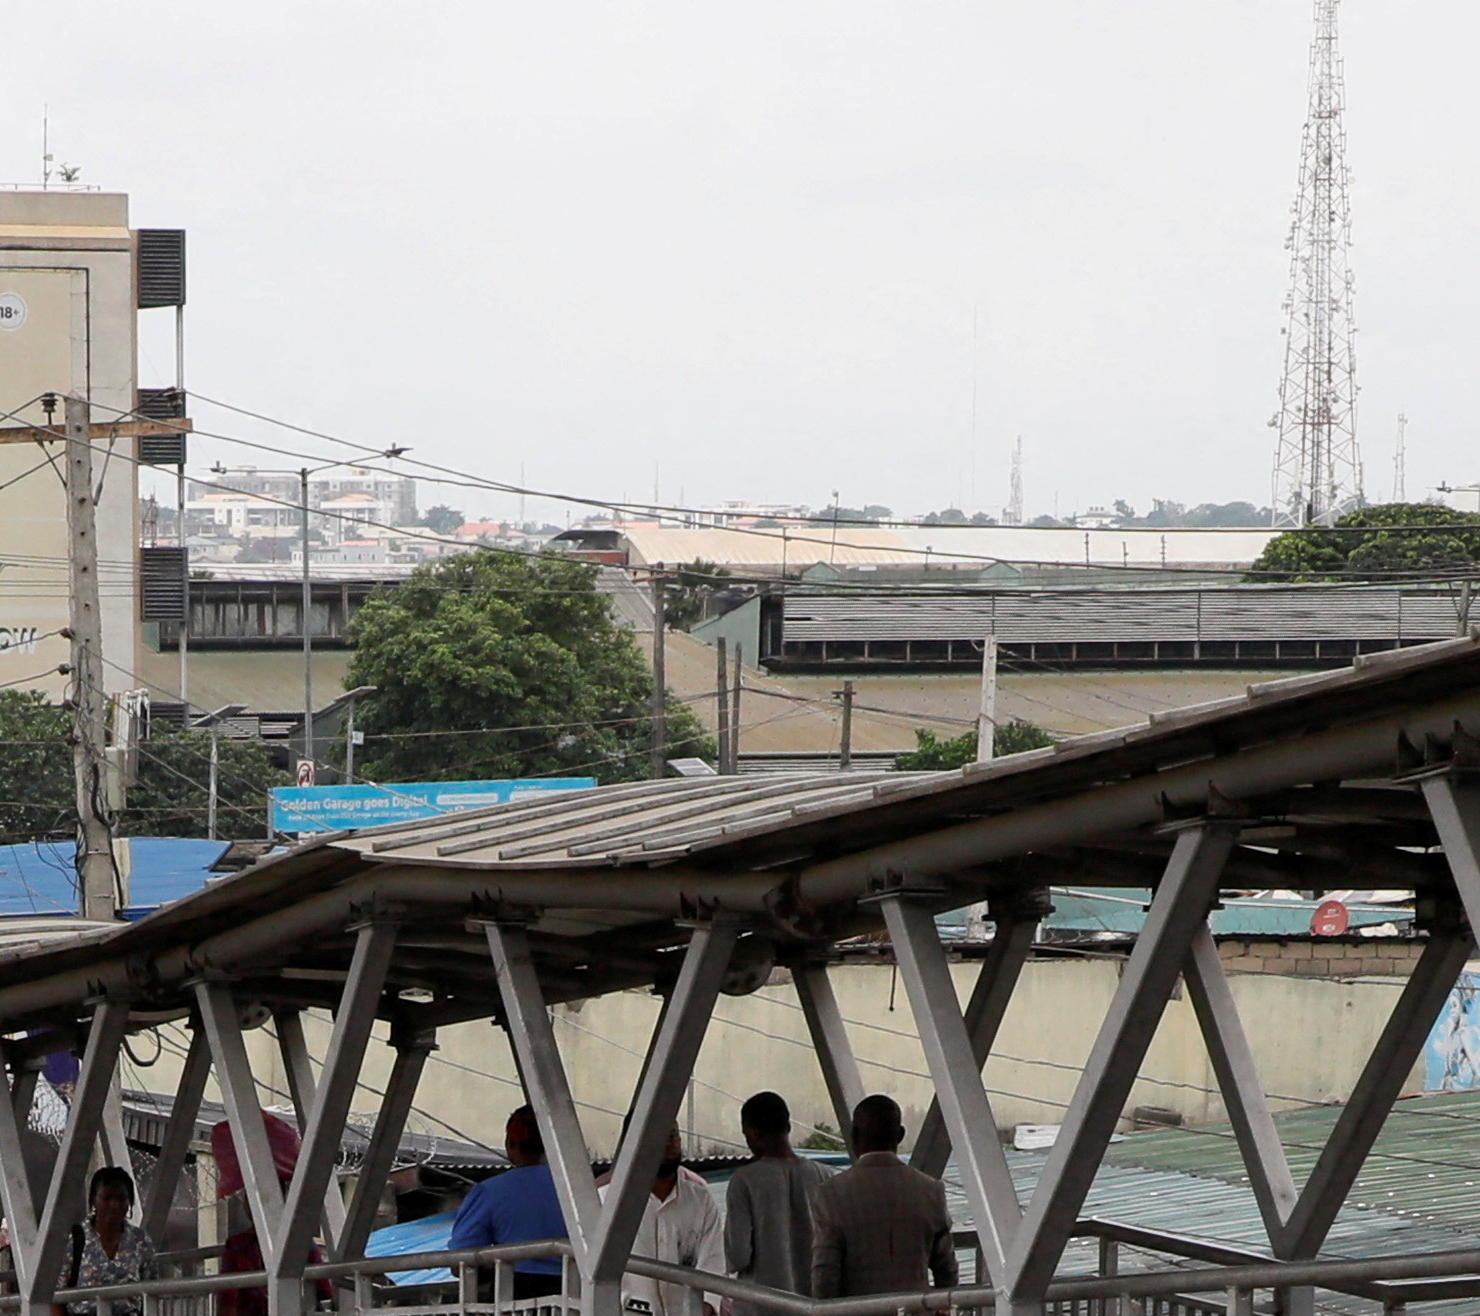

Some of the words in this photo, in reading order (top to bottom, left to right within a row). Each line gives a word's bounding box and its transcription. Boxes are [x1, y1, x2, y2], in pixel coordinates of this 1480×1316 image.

[0, 306, 20, 319] 18+
[324, 798, 361, 811] Garage
[363, 798, 389, 811] goes
